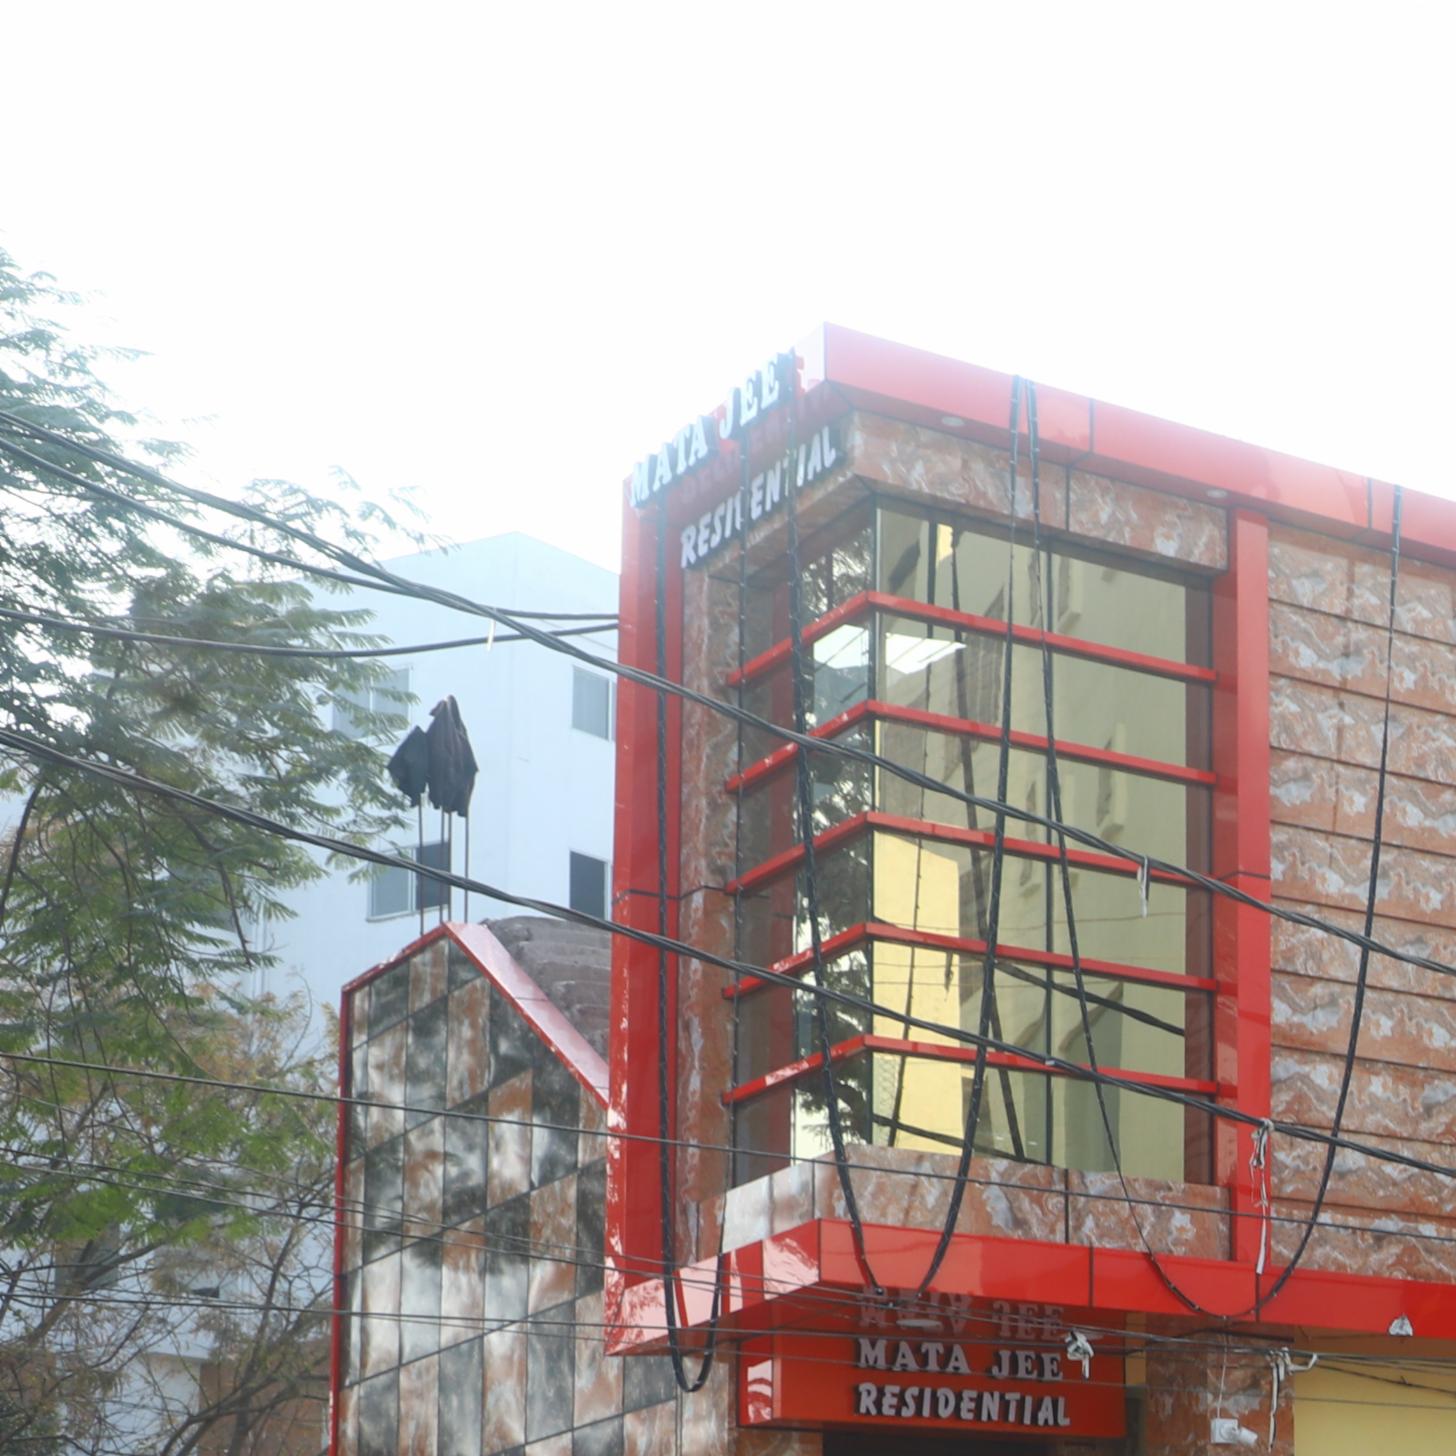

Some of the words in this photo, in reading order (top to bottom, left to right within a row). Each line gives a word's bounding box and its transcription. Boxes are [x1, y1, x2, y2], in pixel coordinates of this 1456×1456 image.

[630, 414, 709, 508] MATA
[719, 360, 781, 440] JEE
[858, 1337, 971, 1375] MATA
[991, 1349, 1064, 1381] JEE
[857, 1382, 1071, 1427] RESIDENTIAL
